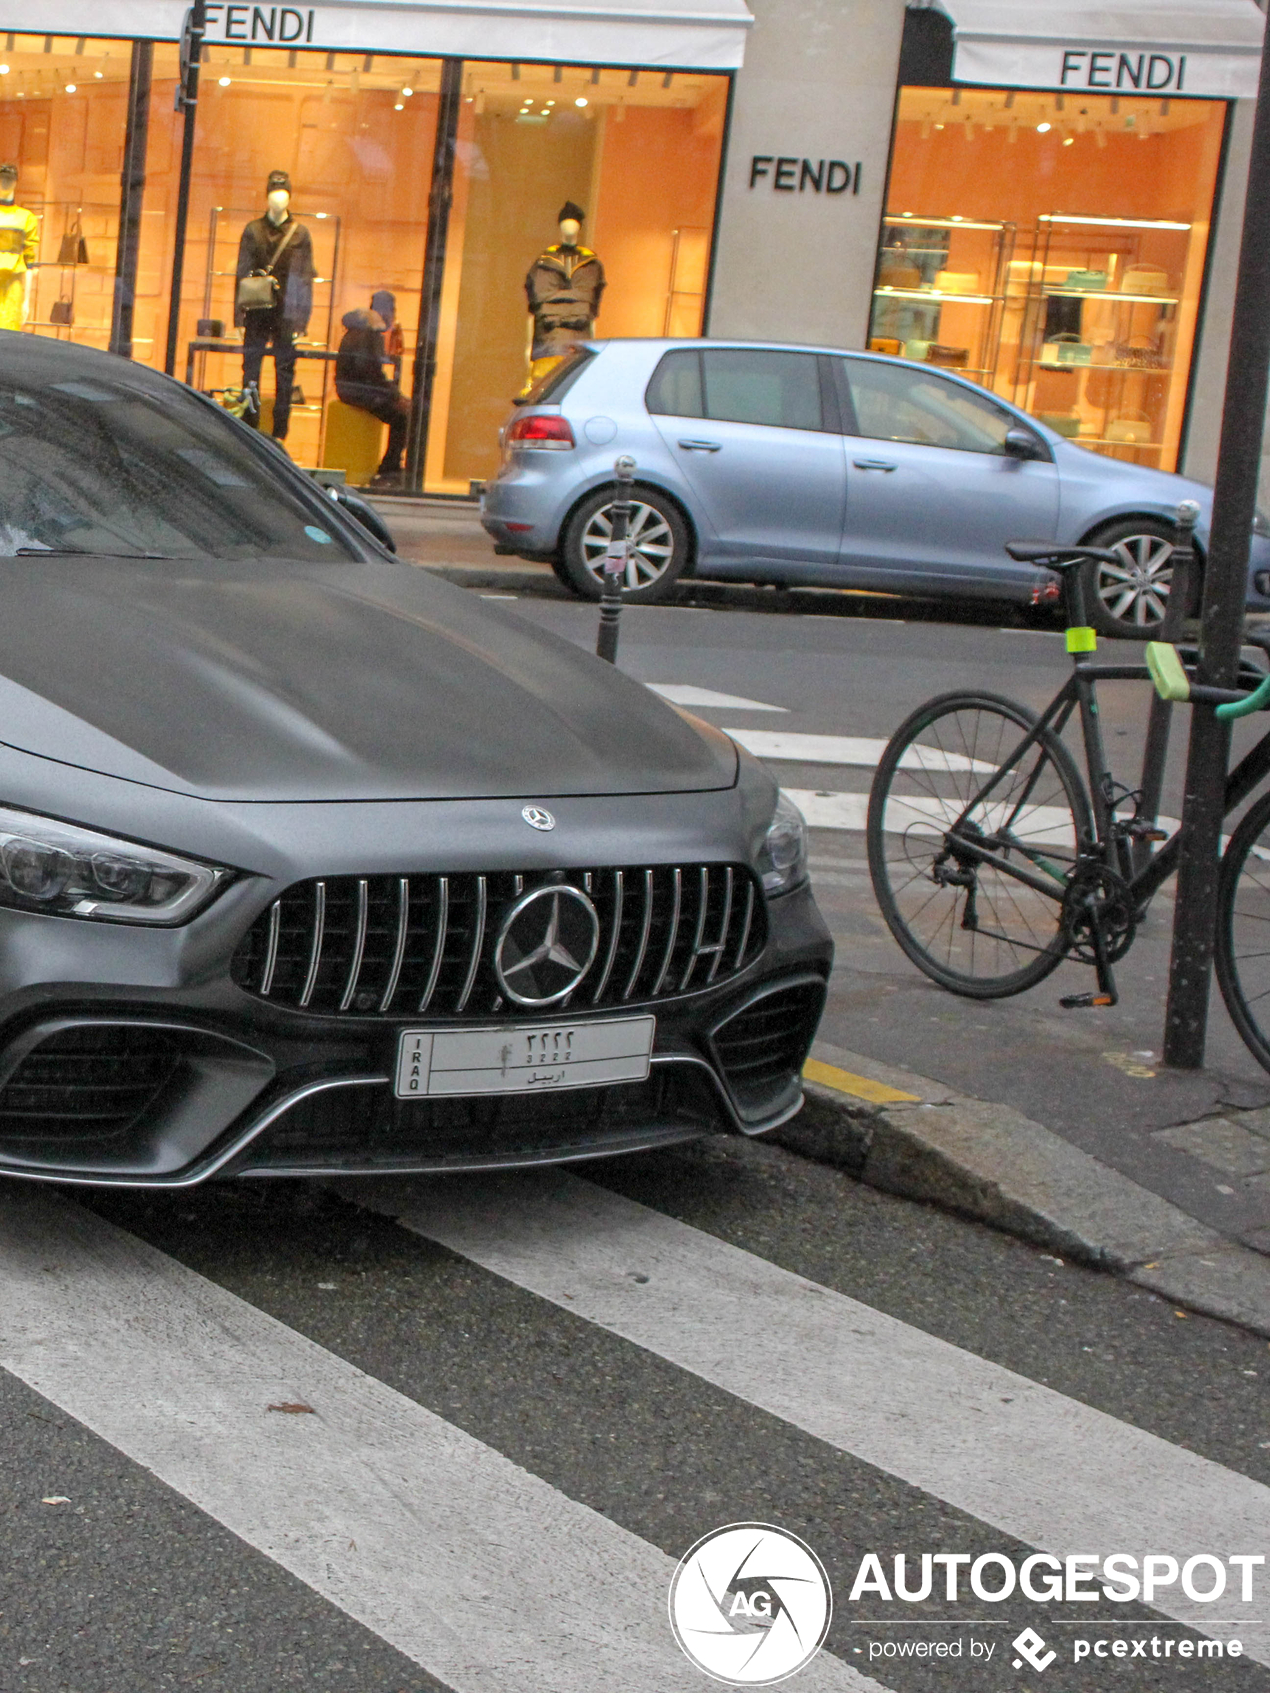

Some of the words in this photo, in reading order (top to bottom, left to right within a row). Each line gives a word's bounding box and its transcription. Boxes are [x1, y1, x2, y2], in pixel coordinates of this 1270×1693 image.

[204, 3, 315, 42] FENDI
[1060, 50, 1187, 90] FENDI
[749, 155, 862, 195] FENDI
[527, 1030, 574, 1052] ٣٢٢٢
[527, 1050, 571, 1064] 3222
[409, 1038, 422, 1090] IRAQ
